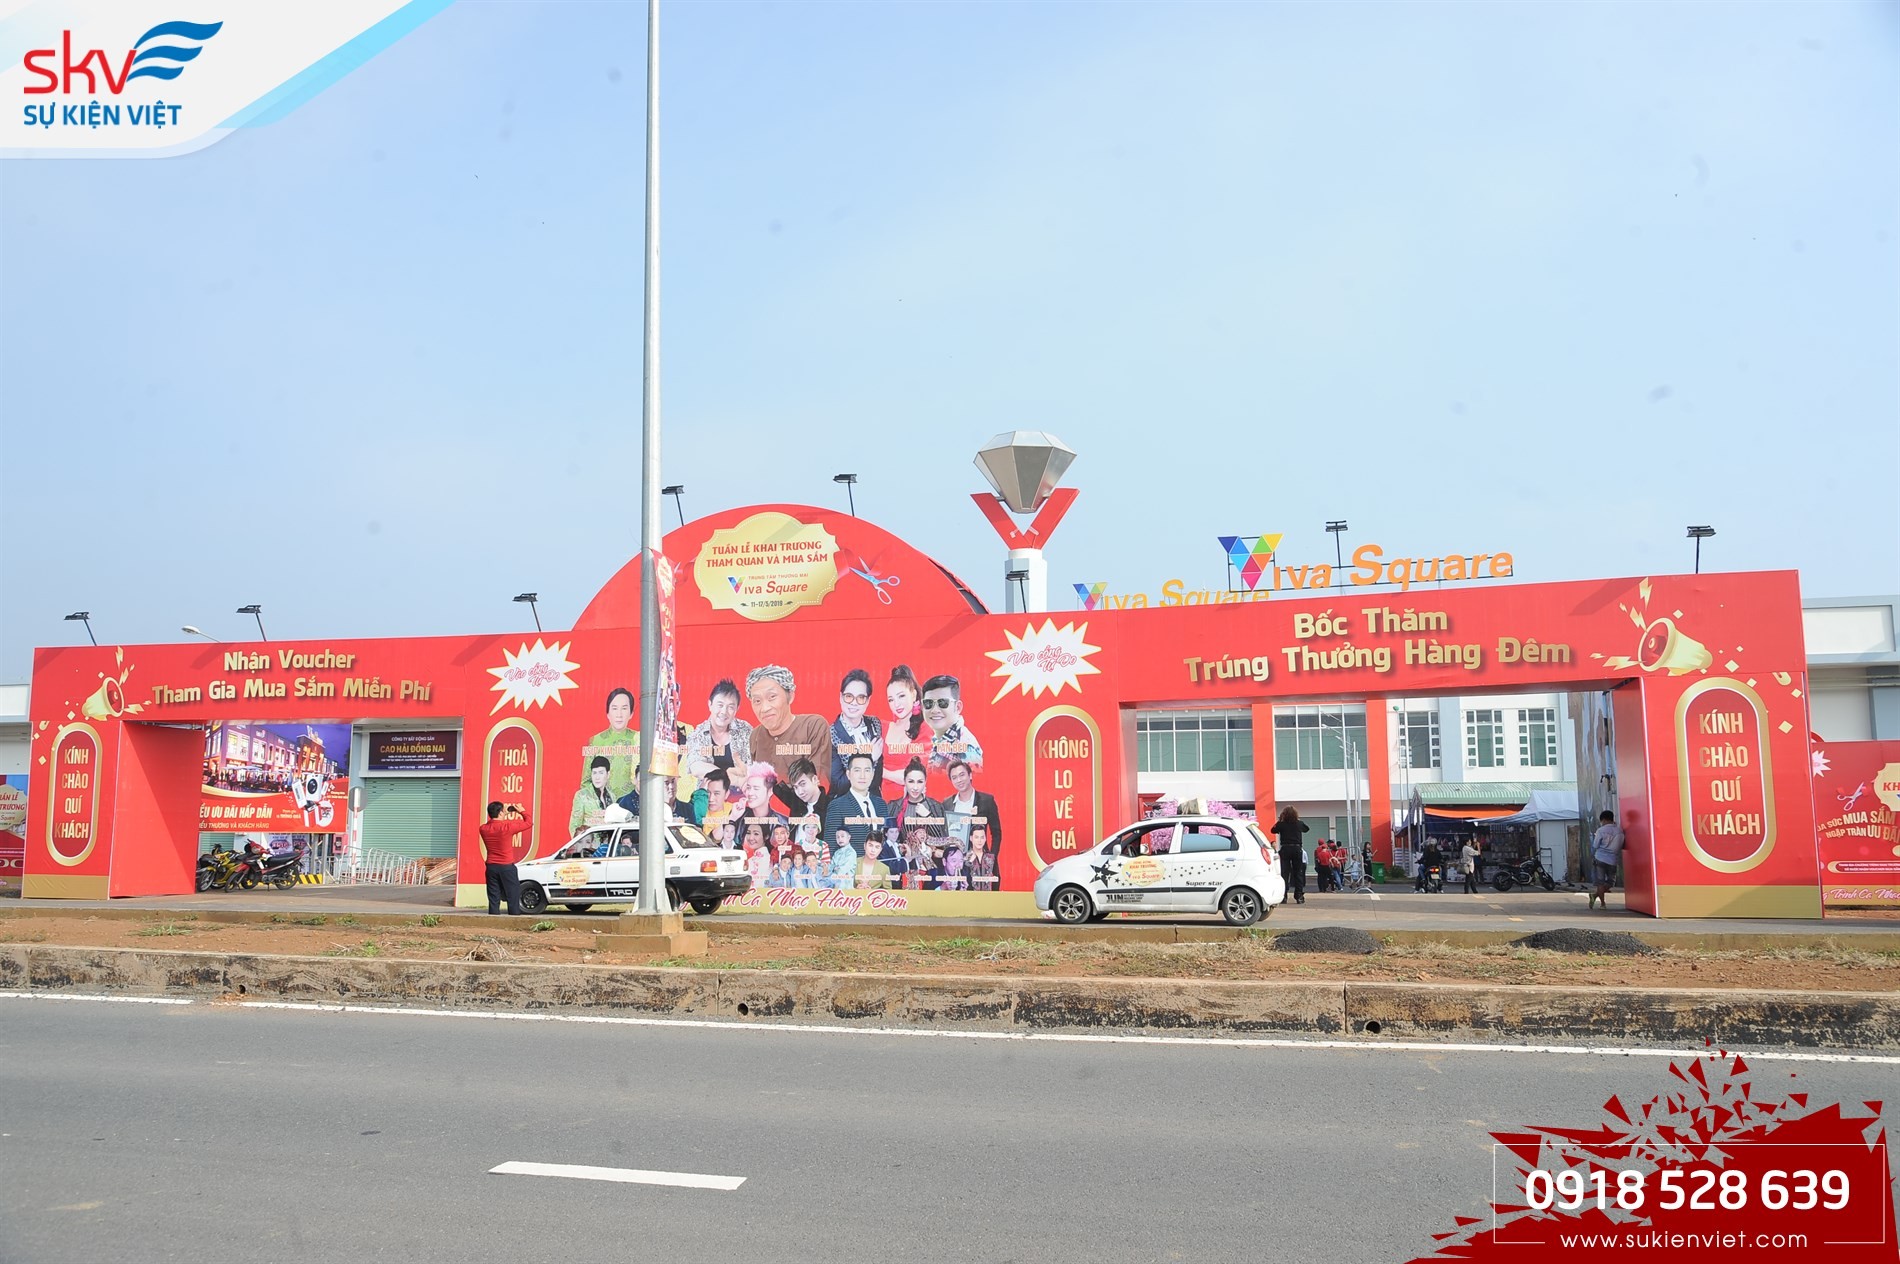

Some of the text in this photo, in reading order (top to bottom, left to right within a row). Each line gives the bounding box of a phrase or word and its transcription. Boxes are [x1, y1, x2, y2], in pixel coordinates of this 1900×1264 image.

[741, 541, 750, 553] LỄ
[753, 543, 777, 553] KHAI
[780, 540, 822, 551] TRƯƠNG
[706, 551, 828, 568] THAM QUAN VÀ MUA SẮM
[1349, 544, 1514, 591] Square
[766, 580, 808, 595] Square
[1294, 606, 1448, 639] Bốc Thăm
[224, 649, 355, 673] Nhận Voucher
[1183, 636, 1571, 682] Trúng Thưởng Hàng Đêm
[152, 675, 432, 704] Tham Gia Mua Sắm Miễn Phí
[1699, 709, 1744, 734] KÍNH
[64, 746, 89, 764] KÍNH
[380, 742, 446, 753] CAO HẢI ĐỒNG NAI
[498, 744, 528, 766] THOẢ
[794, 744, 811, 755] LINH
[909, 743, 924, 755] NGA
[1039, 736, 1089, 759] KHÔNG
[1699, 742, 1749, 768] CHÀO
[62, 770, 89, 789] CHÀO
[501, 773, 523, 793] SỨC
[1054, 769, 1073, 789] LO
[1711, 776, 1742, 802] QUÍ
[65, 795, 83, 814] QUÍ
[224, 804, 238, 819] ĐÃI
[239, 803, 255, 819] HẤP
[1054, 794, 1074, 819] VỀ
[1697, 810, 1761, 835] KHÁCH
[1842, 811, 1868, 825] MUA
[1870, 806, 1896, 826] SẮM
[55, 820, 89, 838] KHÁCH
[1051, 827, 1077, 850] GIÁ
[740, 887, 760, 907] Ca
[767, 887, 809, 911] Nhạc
[813, 887, 862, 915] Hàng
[867, 889, 908, 909] Đêm
